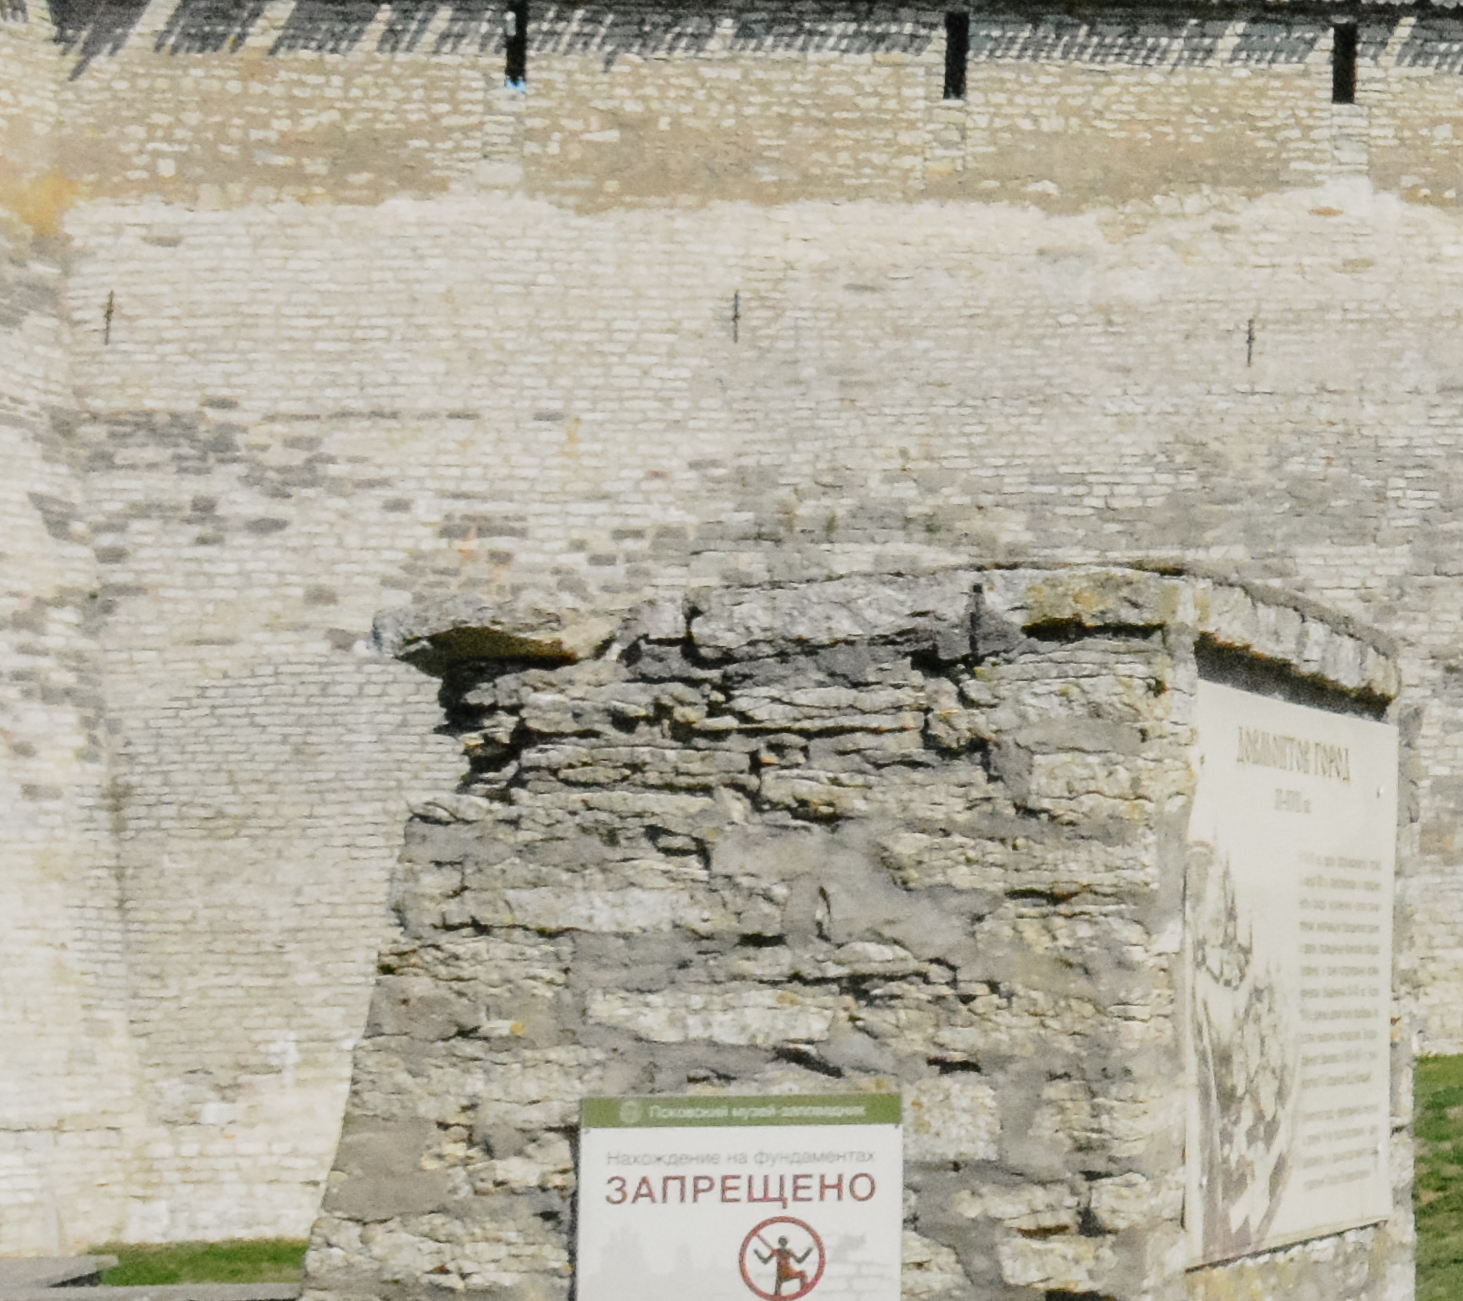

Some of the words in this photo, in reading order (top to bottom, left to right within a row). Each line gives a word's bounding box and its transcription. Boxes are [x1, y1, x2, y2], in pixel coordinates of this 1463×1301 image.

[606, 1150, 721, 1167] Нахождение
[727, 1152, 748, 1165] на
[754, 1148, 876, 1168] фундаментах
[605, 1172, 877, 1210] ЗАПРЕЩЕНО
